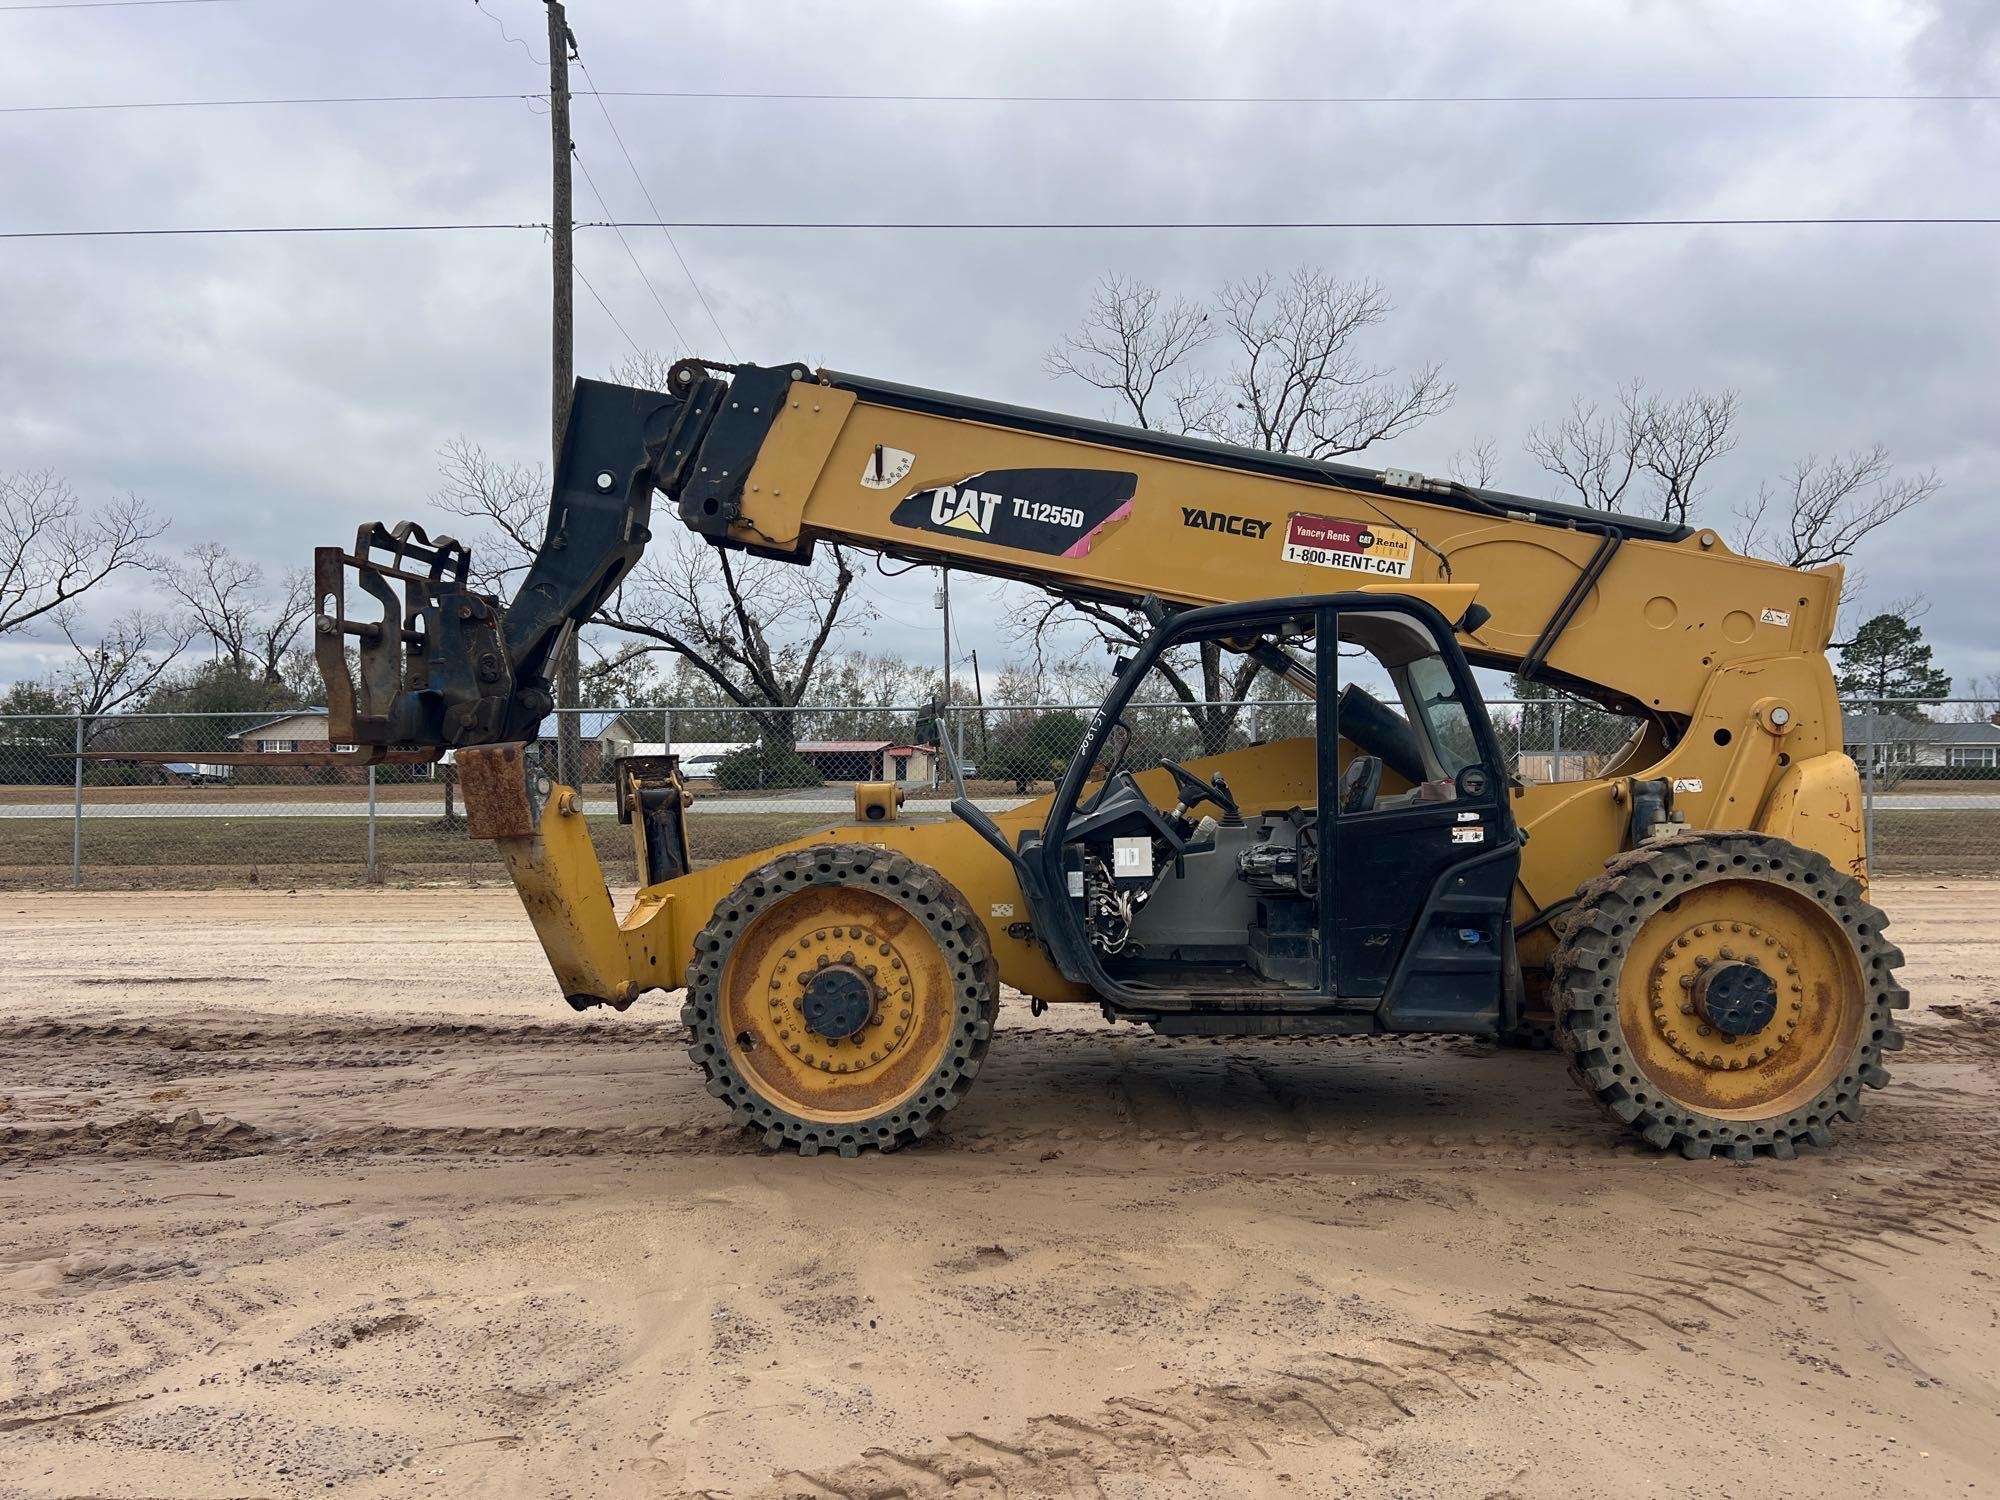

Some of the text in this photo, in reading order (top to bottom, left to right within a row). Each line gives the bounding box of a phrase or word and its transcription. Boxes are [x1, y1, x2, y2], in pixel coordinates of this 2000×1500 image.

[931, 486, 1085, 534] CAT TL1255D
[1181, 507, 1272, 539] YANCEY
[1296, 525, 1326, 541] Yancey
[1327, 530, 1351, 542] Rents
[1358, 534, 1373, 545] CAT
[1375, 537, 1408, 550] Rental
[1289, 547, 1406, 575] 1-800-RENT-CAT
